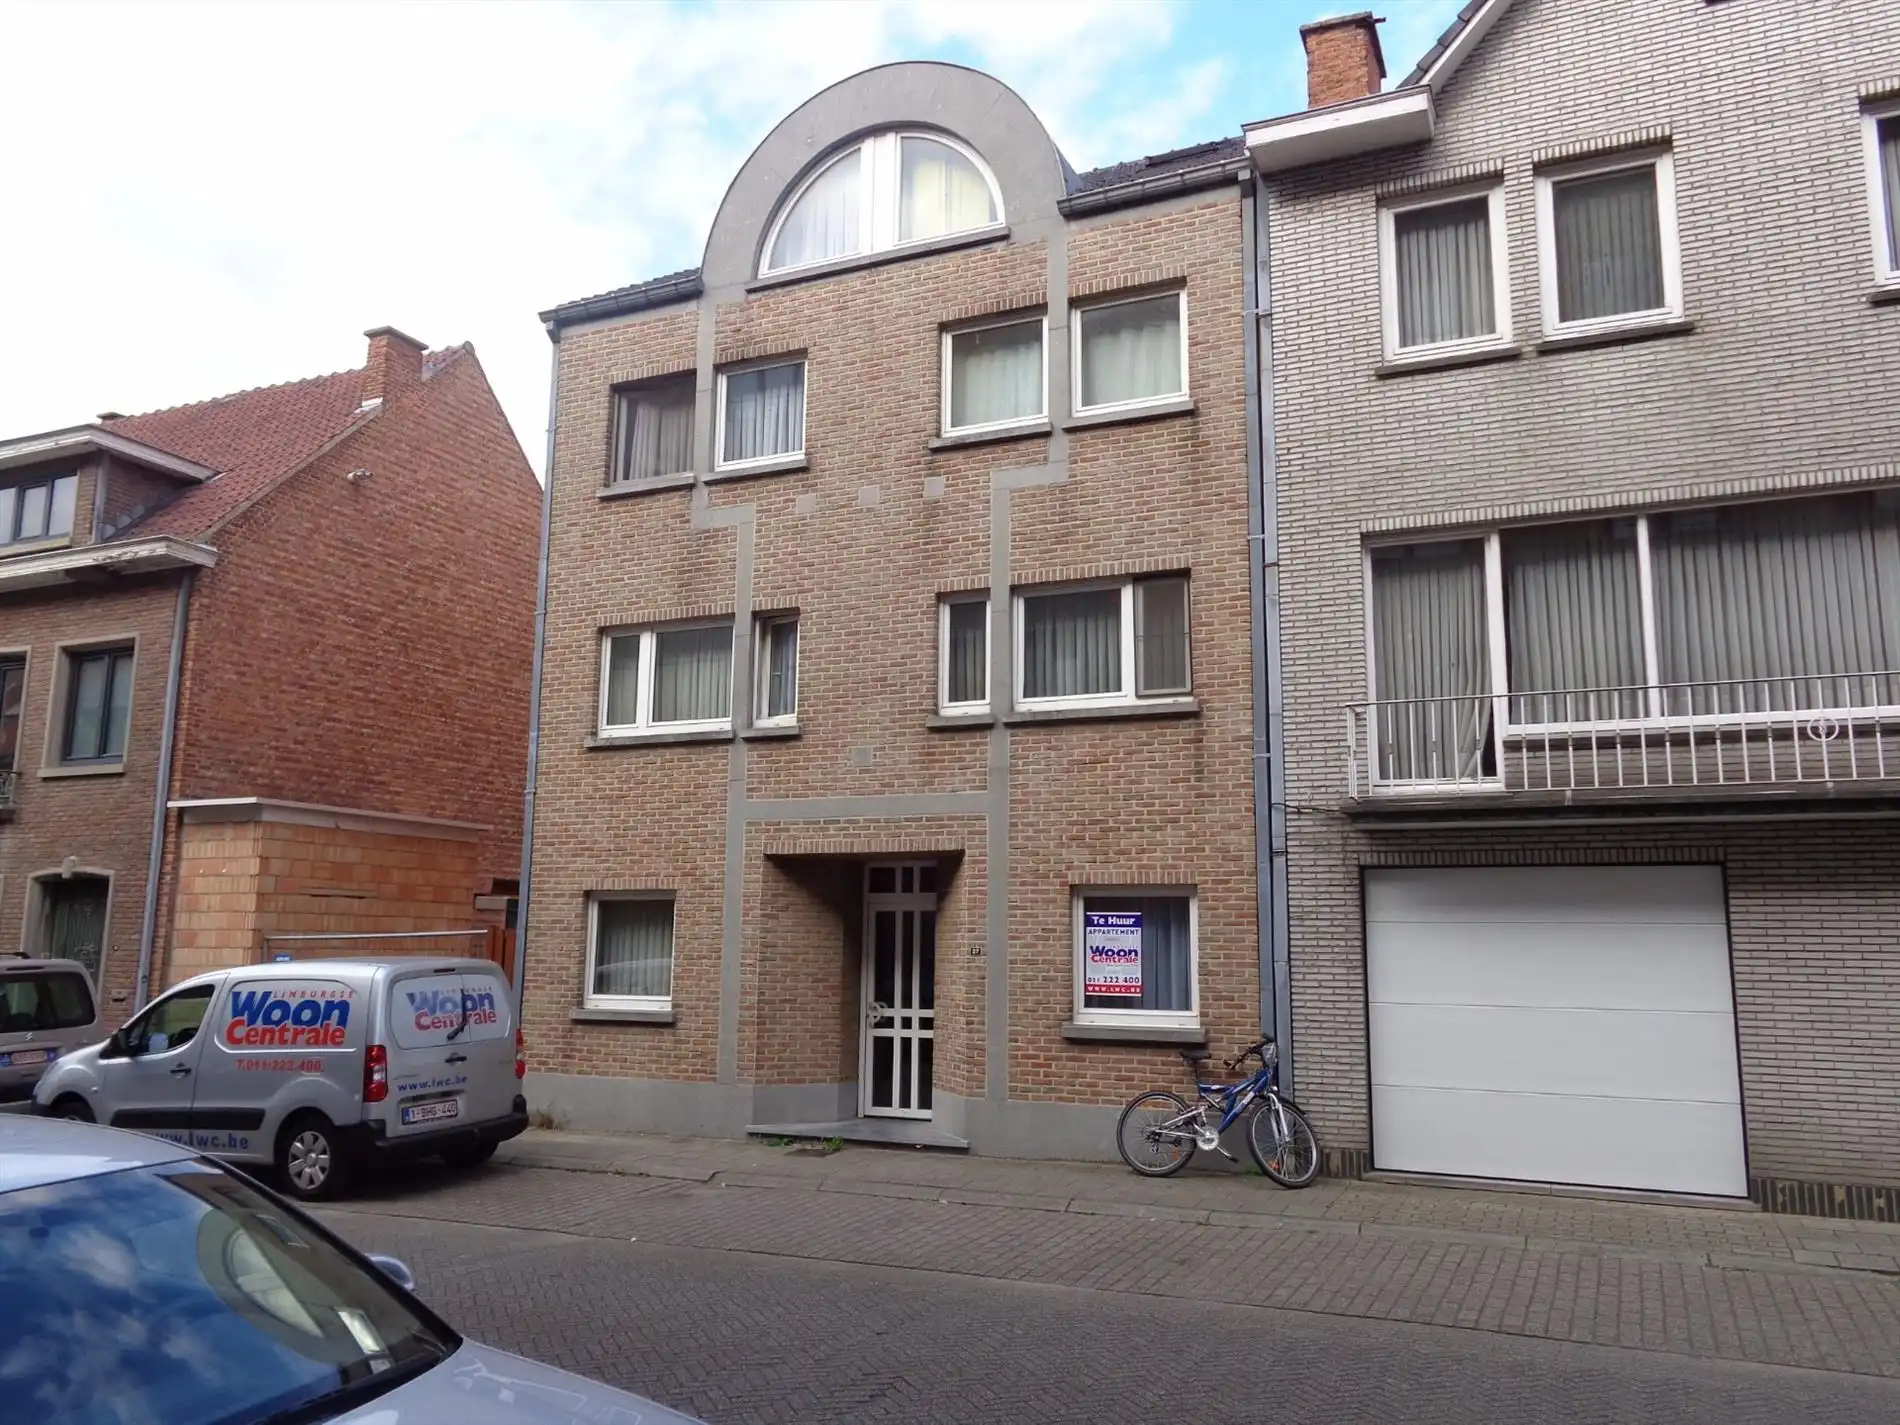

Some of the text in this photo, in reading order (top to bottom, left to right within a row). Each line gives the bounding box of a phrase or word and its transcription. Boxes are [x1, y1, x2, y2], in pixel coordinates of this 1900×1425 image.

[1092, 916, 1136, 925] Te Huur
[1090, 946, 1139, 957] Woon
[1091, 955, 1139, 963] Centrale
[1103, 976, 1120, 984] 222
[1123, 976, 1140, 984] 400
[272, 989, 355, 999] LIMBURGSE
[406, 991, 496, 1017] Woon
[231, 990, 350, 1031] Woon
[226, 1018, 346, 1047] Centrale
[398, 1075, 468, 1092] www.lwc.be
